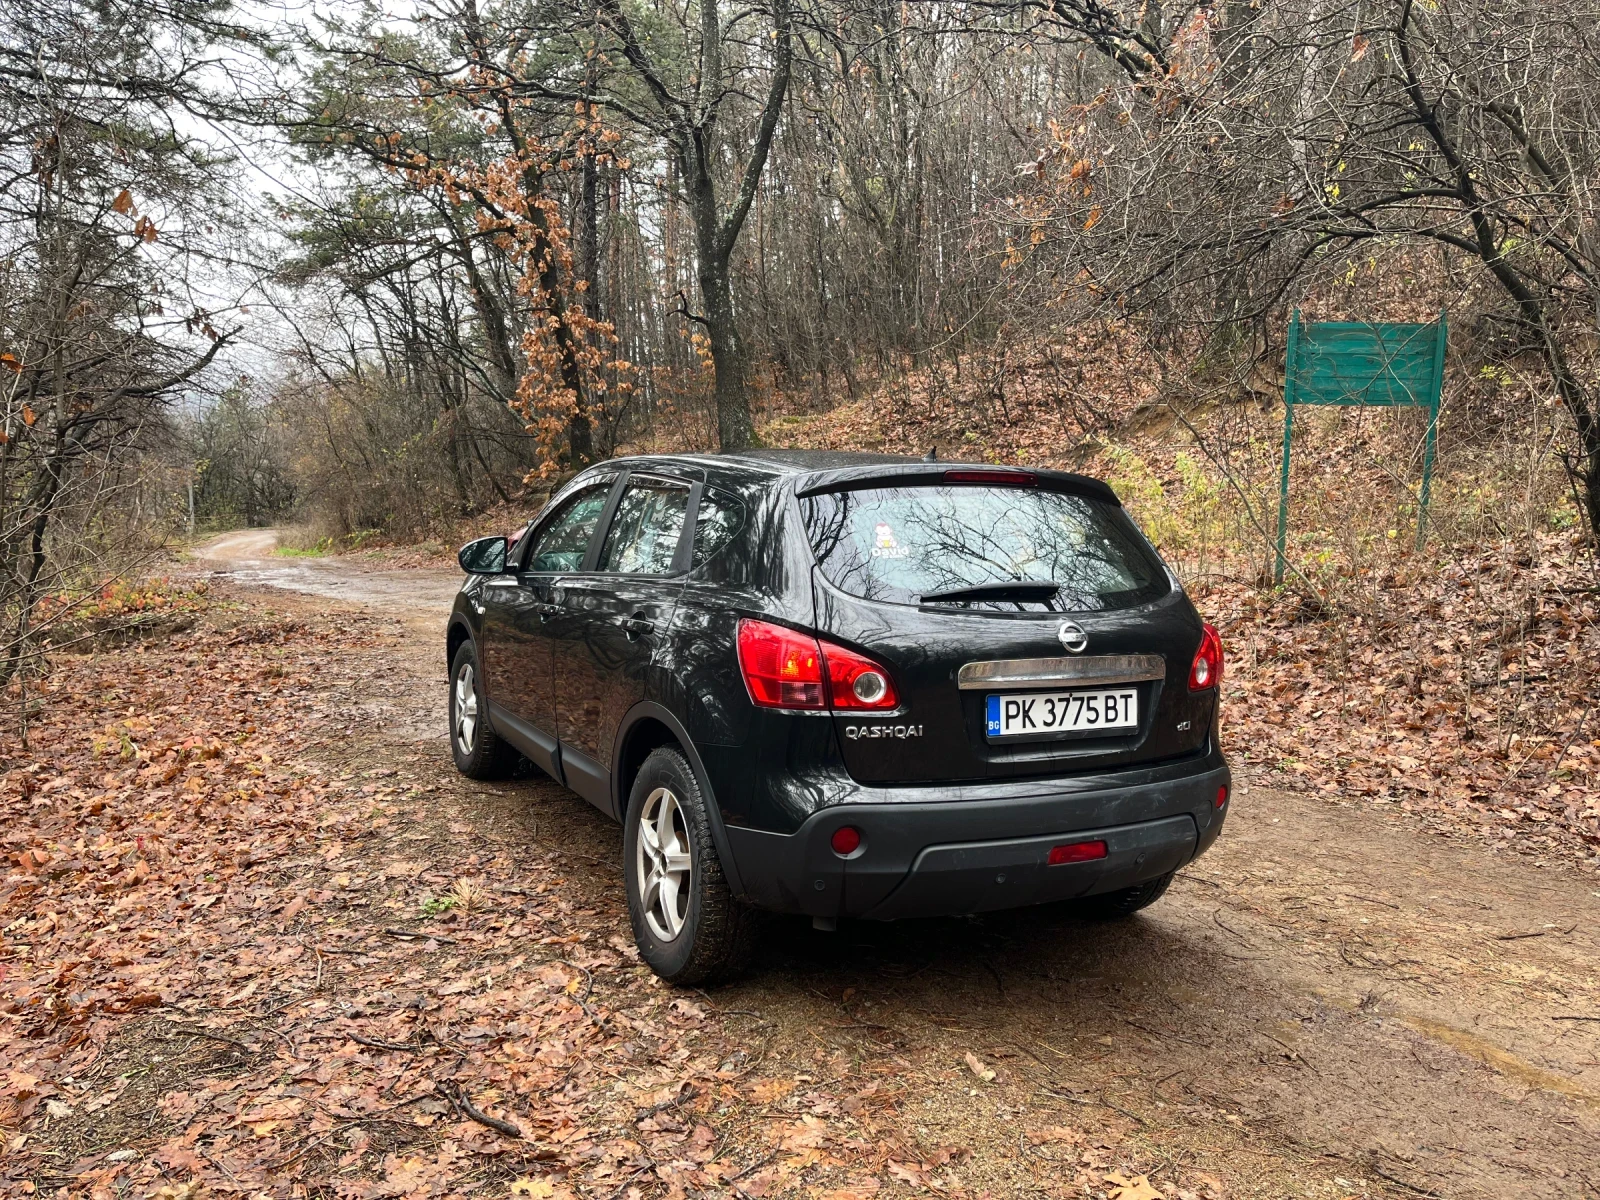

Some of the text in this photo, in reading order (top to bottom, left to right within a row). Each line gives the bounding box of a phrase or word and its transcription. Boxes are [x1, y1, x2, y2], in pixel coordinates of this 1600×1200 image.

[871, 545, 909, 557] David
[1005, 693, 1133, 730] PK 3775 BT
[988, 720, 1000, 730] BG
